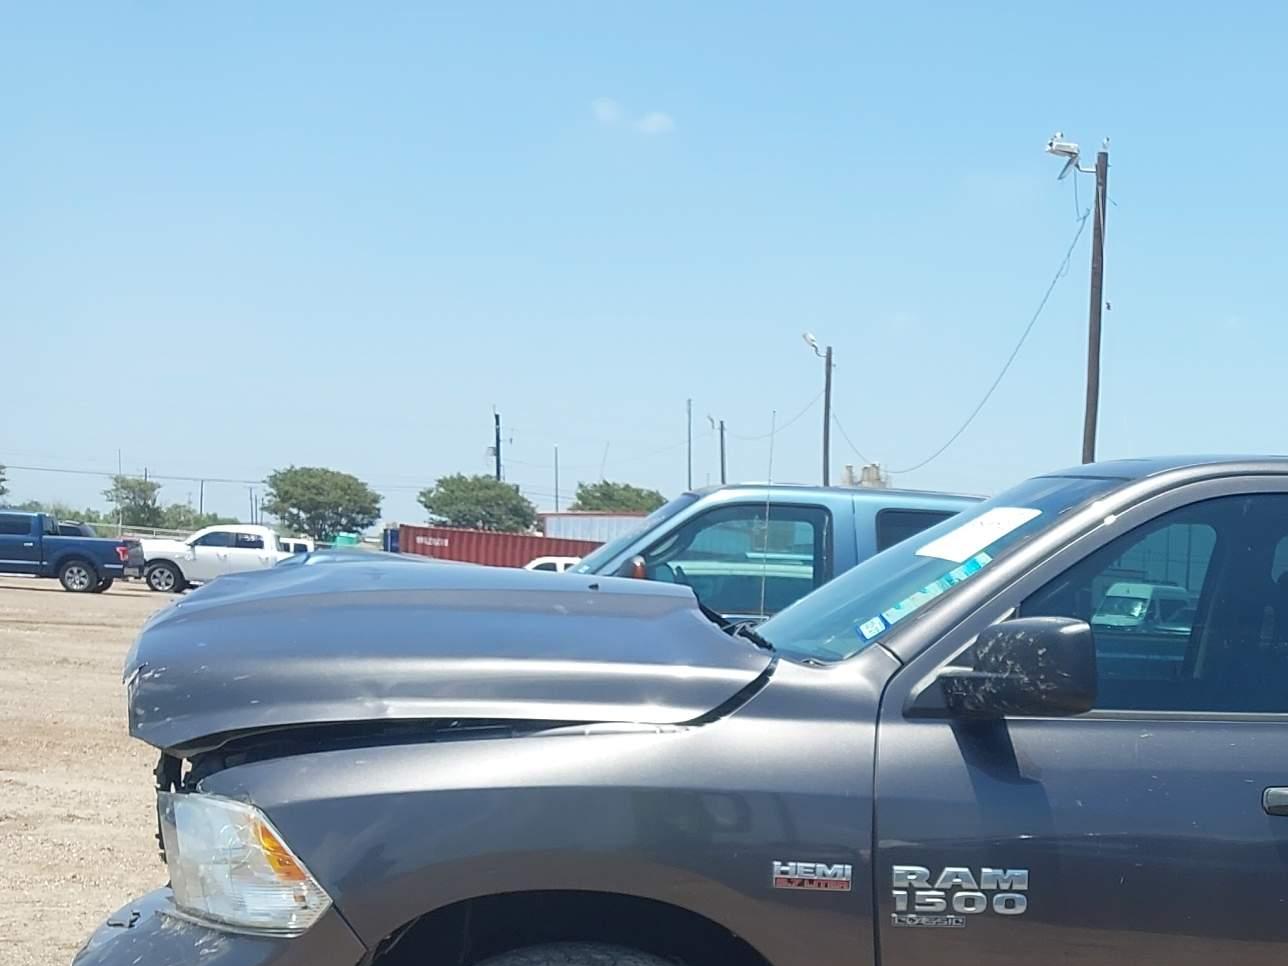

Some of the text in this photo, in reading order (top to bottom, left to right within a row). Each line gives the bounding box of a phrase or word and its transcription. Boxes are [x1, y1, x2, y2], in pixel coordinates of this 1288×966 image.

[773, 861, 852, 879] HEMI
[892, 865, 1029, 890] RAM
[892, 890, 1028, 915] 1500
